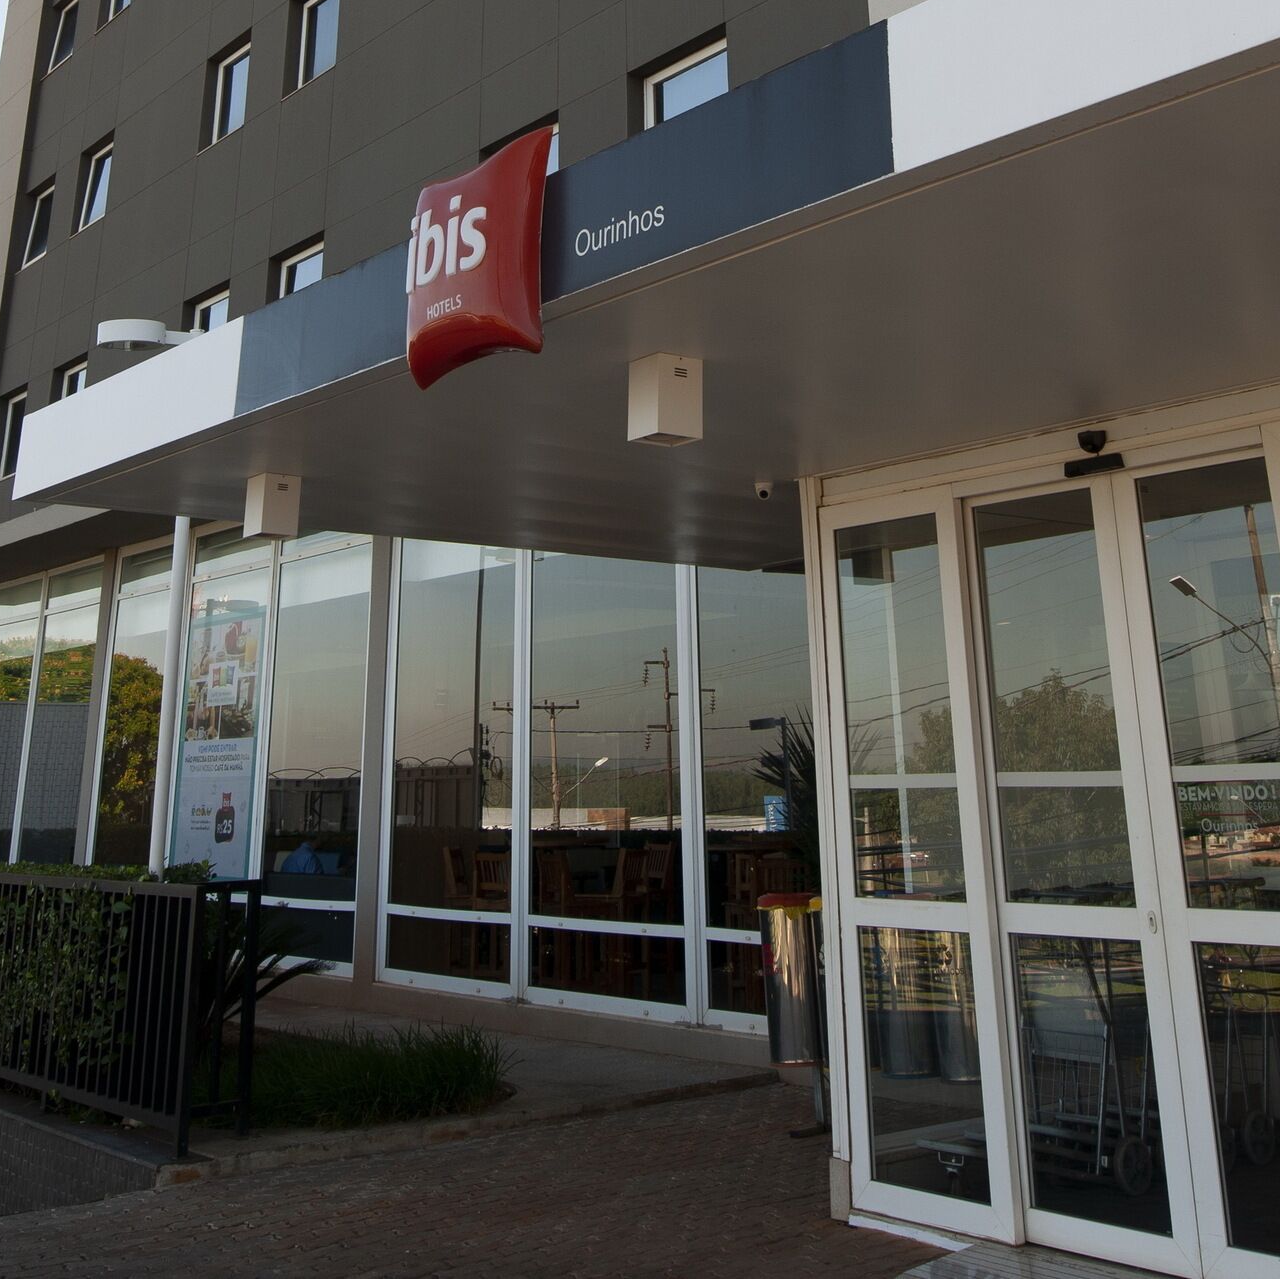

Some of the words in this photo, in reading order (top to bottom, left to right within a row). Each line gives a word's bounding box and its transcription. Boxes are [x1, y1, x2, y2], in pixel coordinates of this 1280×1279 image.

[406, 194, 487, 294] ibis
[574, 205, 665, 257] Ourinhos
[427, 294, 462, 320] HOTELS
